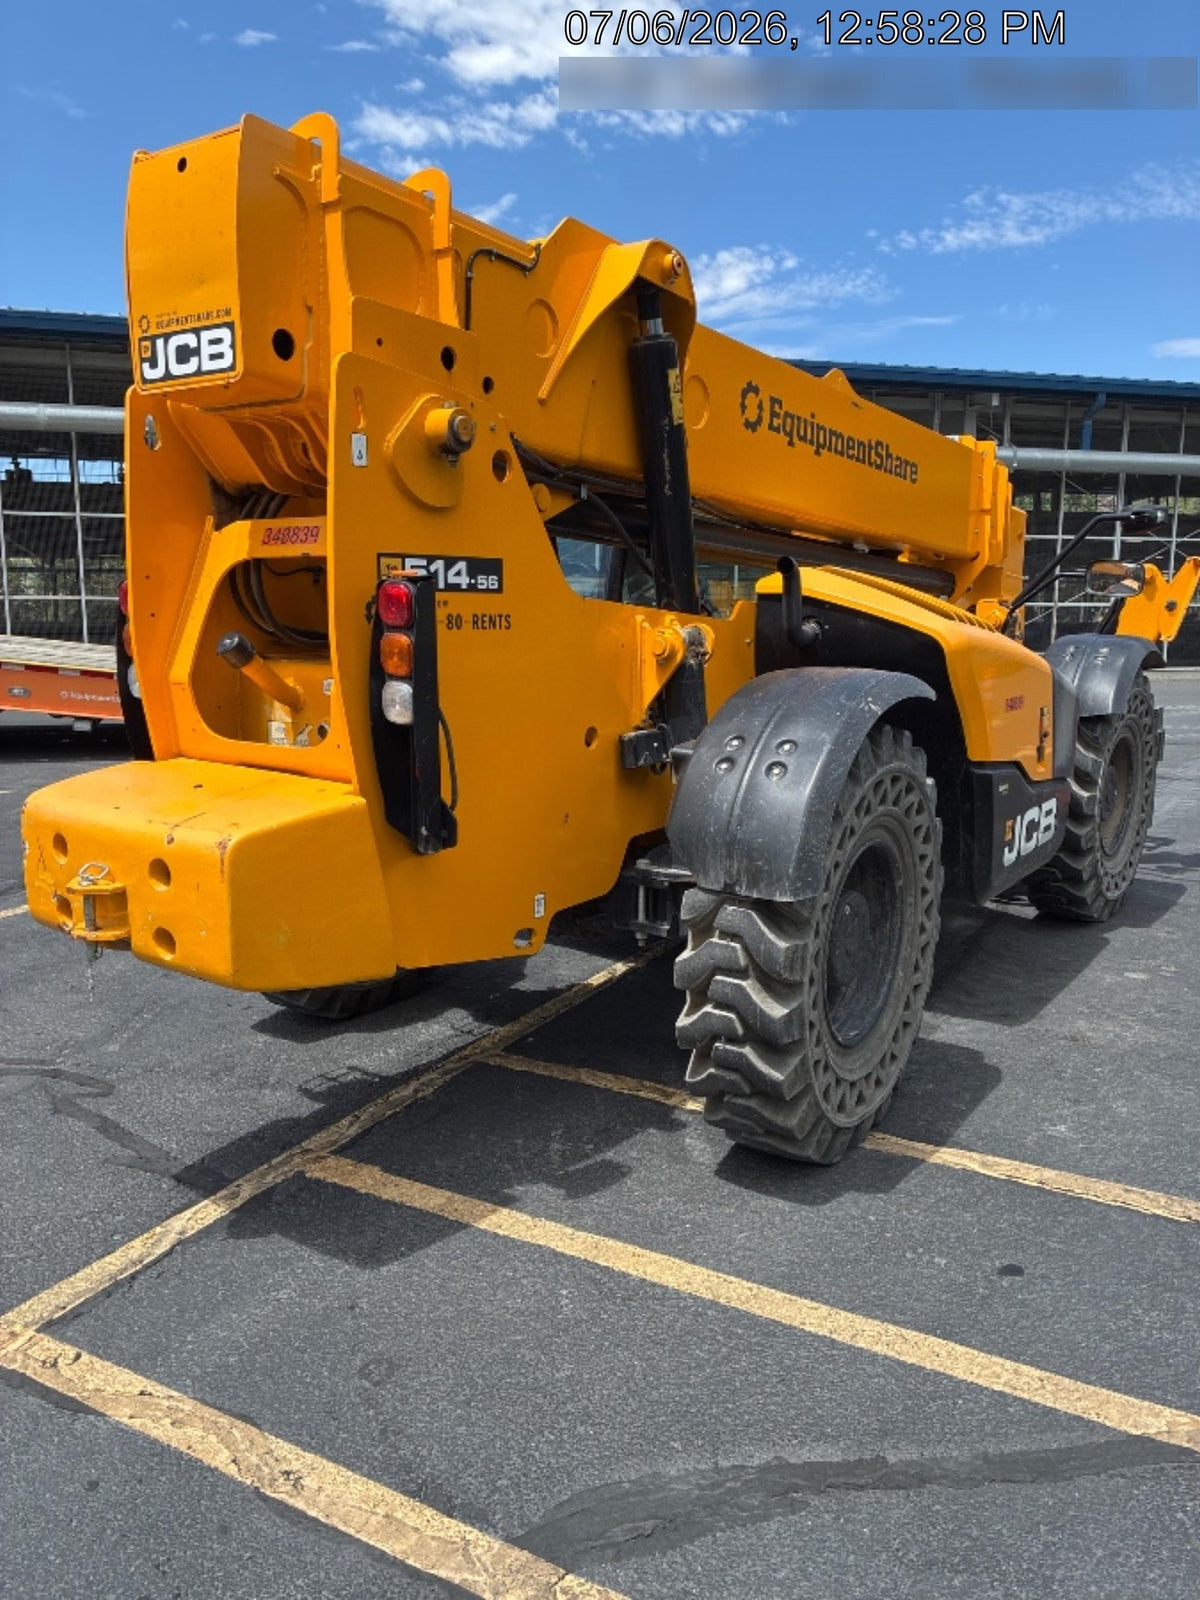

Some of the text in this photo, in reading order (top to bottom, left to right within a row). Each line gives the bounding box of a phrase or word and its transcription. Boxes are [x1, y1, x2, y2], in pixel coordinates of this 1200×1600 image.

[141, 327, 233, 379] JCB
[768, 395, 918, 484] EquipmentShare
[1003, 798, 1057, 866] JCB
